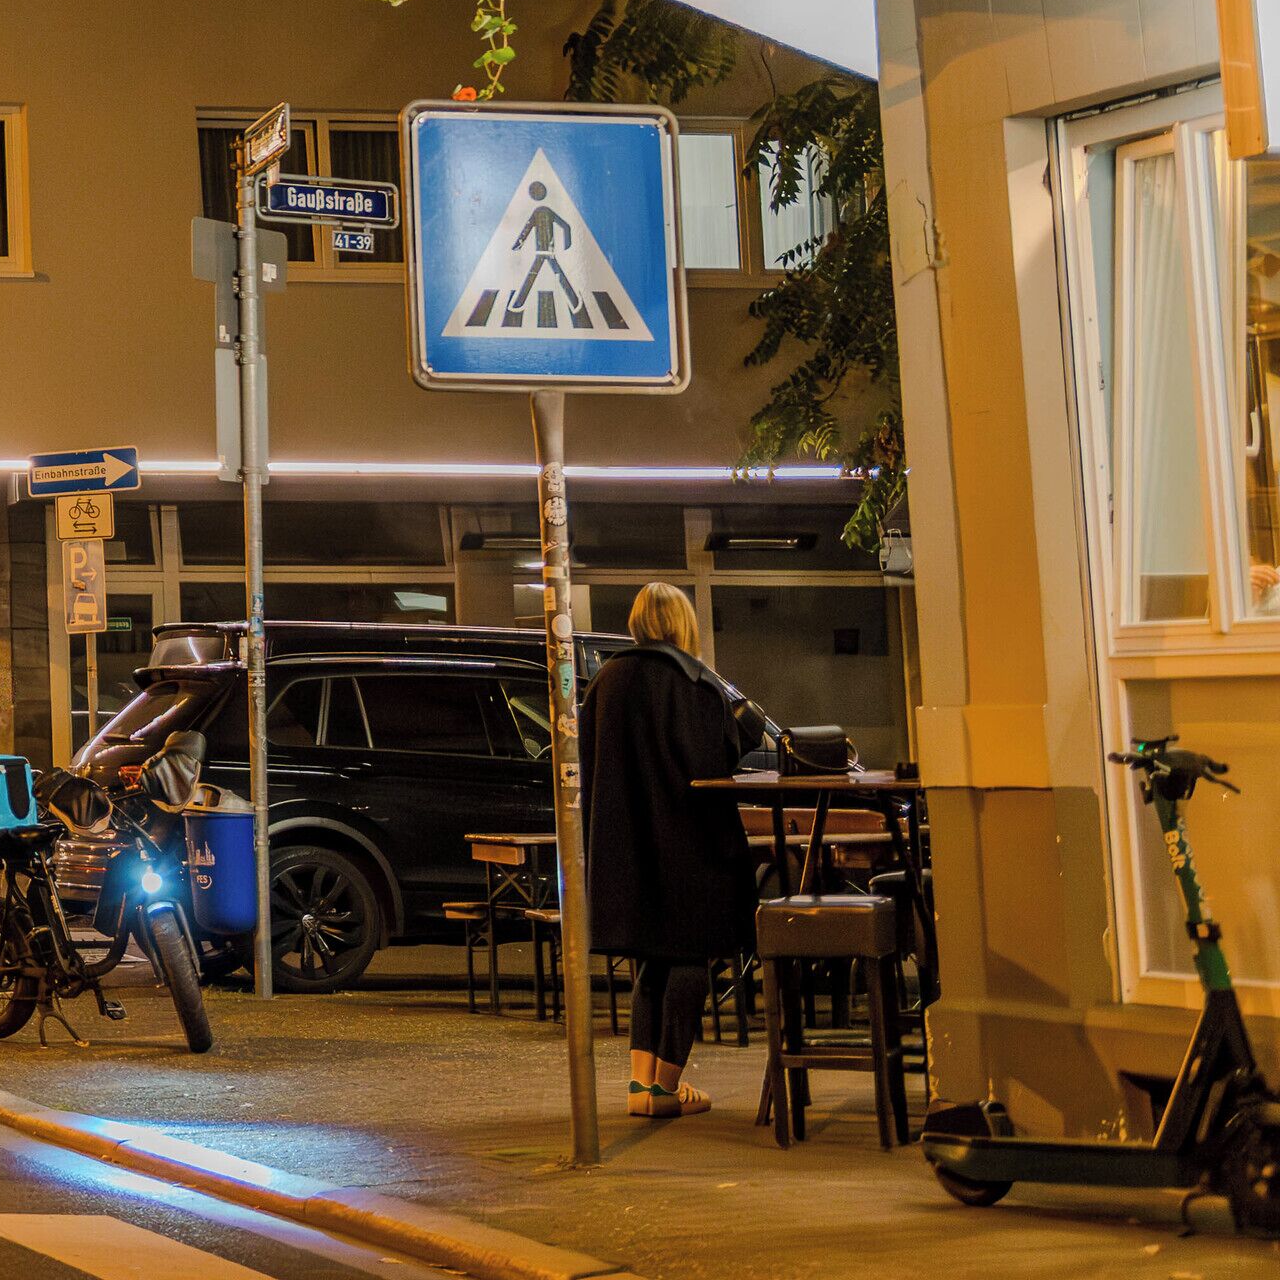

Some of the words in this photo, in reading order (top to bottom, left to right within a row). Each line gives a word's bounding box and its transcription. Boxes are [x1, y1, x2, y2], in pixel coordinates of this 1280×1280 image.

[287, 186, 373, 214] Gaußstraße
[334, 233, 372, 250] 41-39
[34, 465, 107, 480] Einbahnstraße
